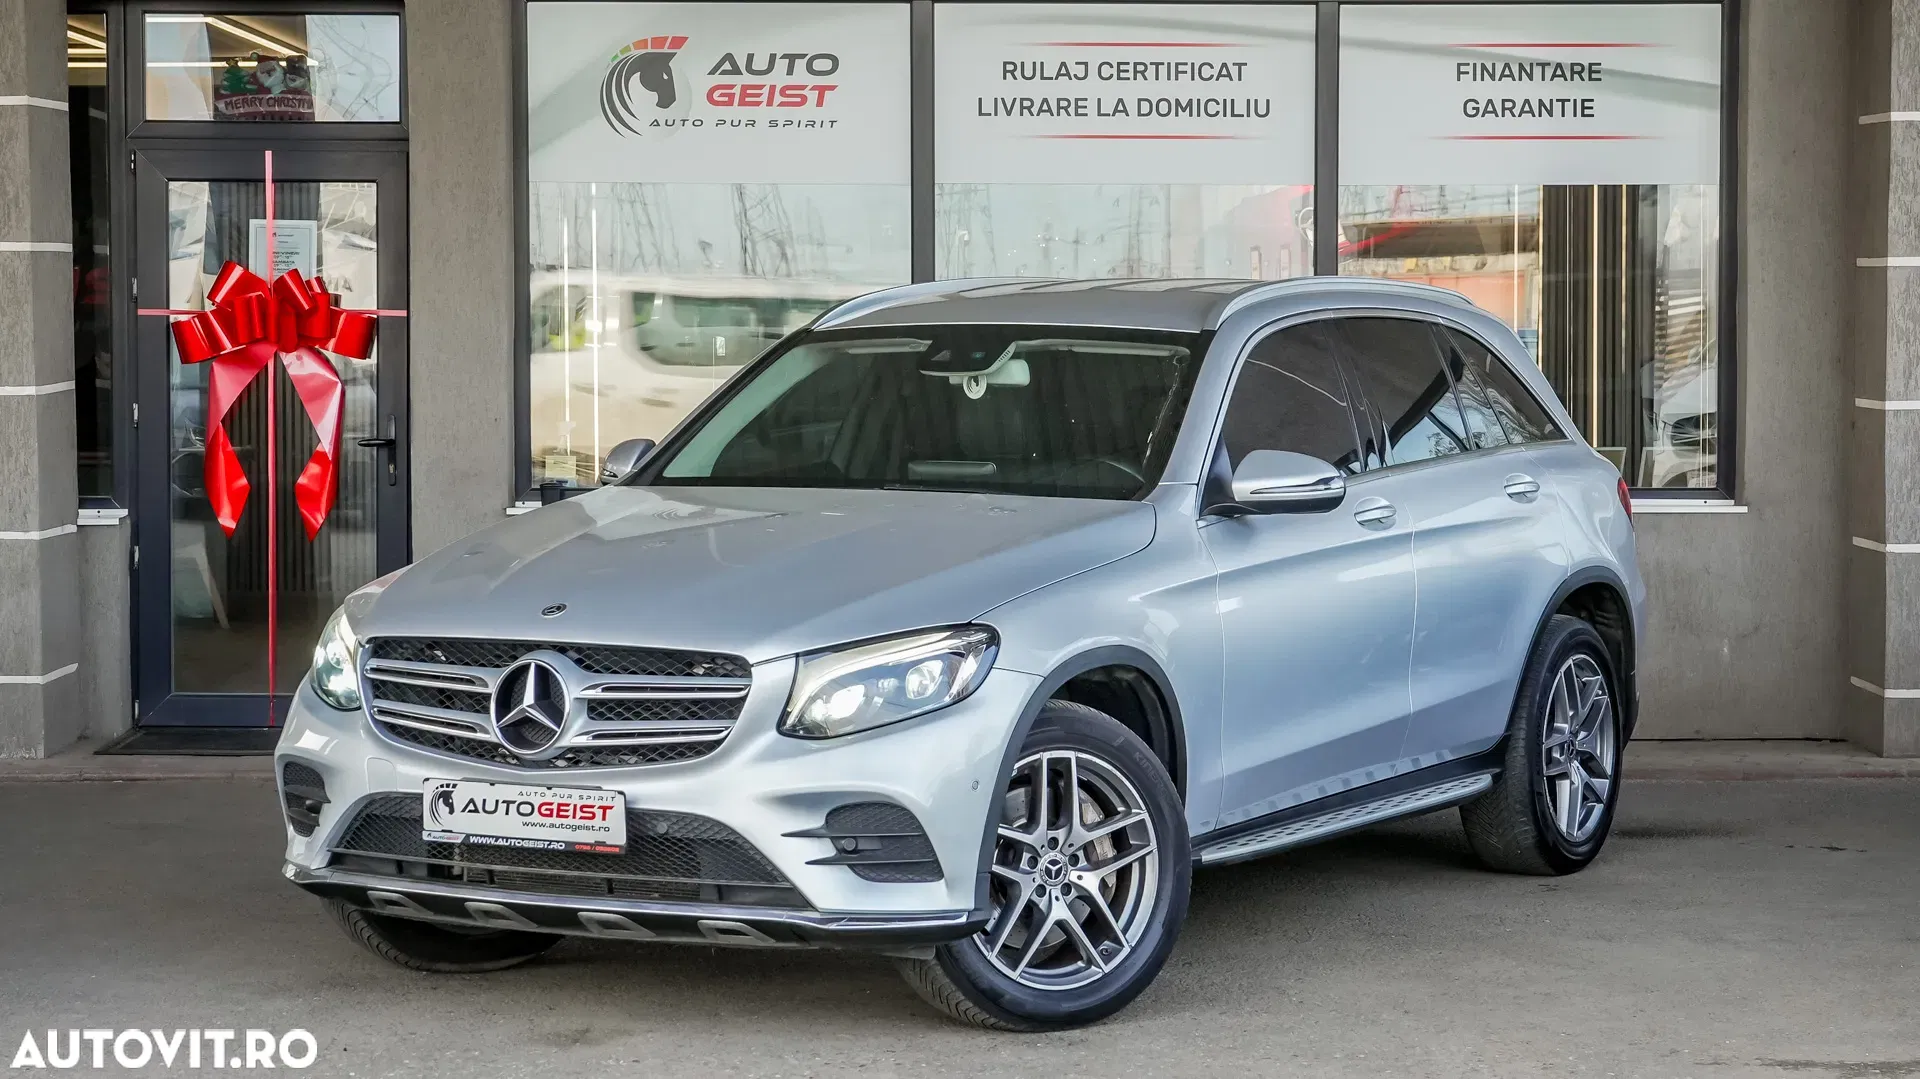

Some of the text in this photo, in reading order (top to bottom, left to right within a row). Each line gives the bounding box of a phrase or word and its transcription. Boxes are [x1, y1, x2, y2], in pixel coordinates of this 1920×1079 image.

[706, 52, 840, 76] AUTO
[1002, 61, 1248, 82] RULAJ CERTIFICAT
[1456, 62, 1603, 82] FINANTARE
[224, 97, 262, 111] MERRY
[706, 84, 839, 107] GEIST
[977, 97, 1271, 119] LIVRARE LA DOMICILIU
[1462, 98, 1595, 118] GARANTIE
[649, 118, 838, 128] AUTO PUR SPIRIT
[517, 790, 616, 802] AUTO PUR SPIRIT
[460, 797, 616, 822] AUTOGEIST
[521, 820, 610, 832] www.autogeist.ro
[469, 835, 566, 850] WWW.AUTOGEIST.RO
